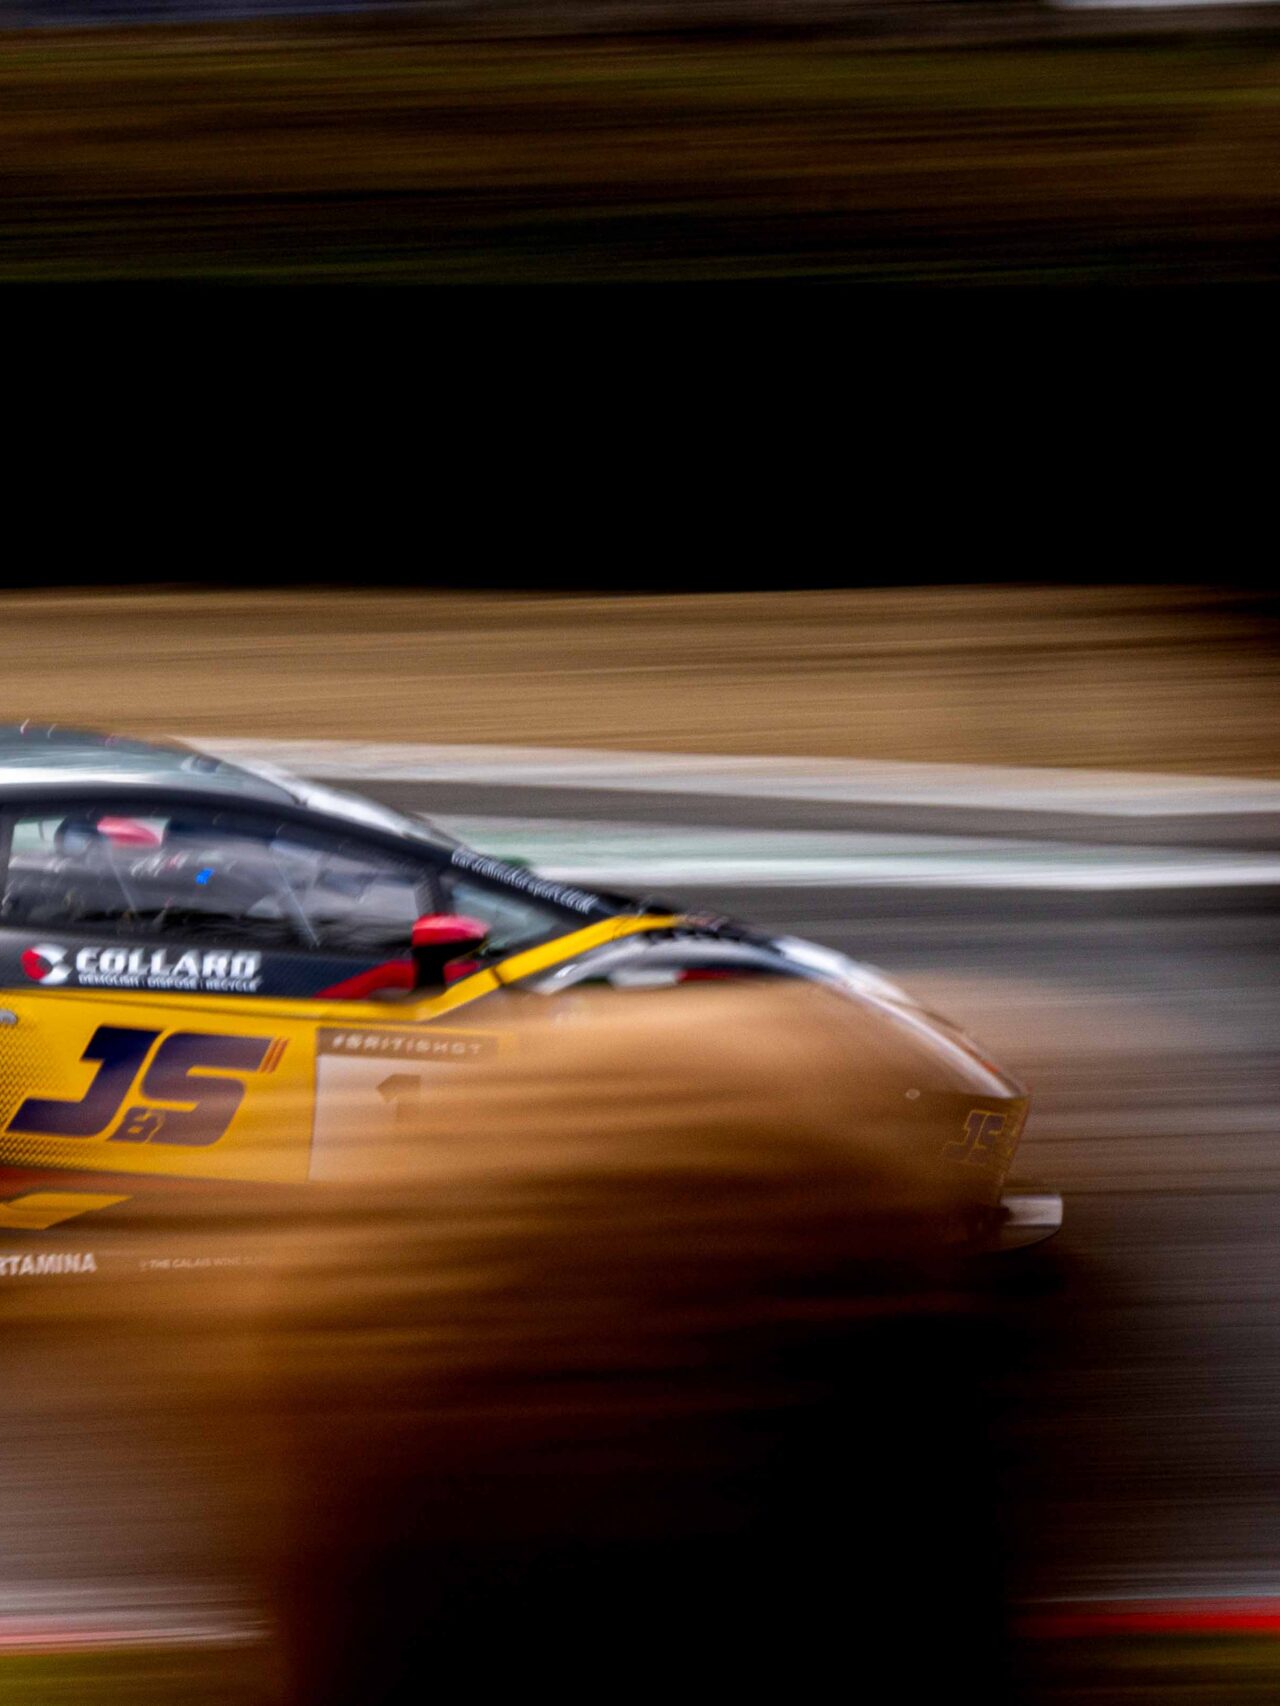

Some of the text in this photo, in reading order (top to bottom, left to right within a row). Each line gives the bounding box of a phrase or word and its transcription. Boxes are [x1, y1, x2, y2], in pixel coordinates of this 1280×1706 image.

[75, 946, 263, 979] COLLARD
[78, 973, 263, 993] DEMOLISH DISPOSE RECYCLE
